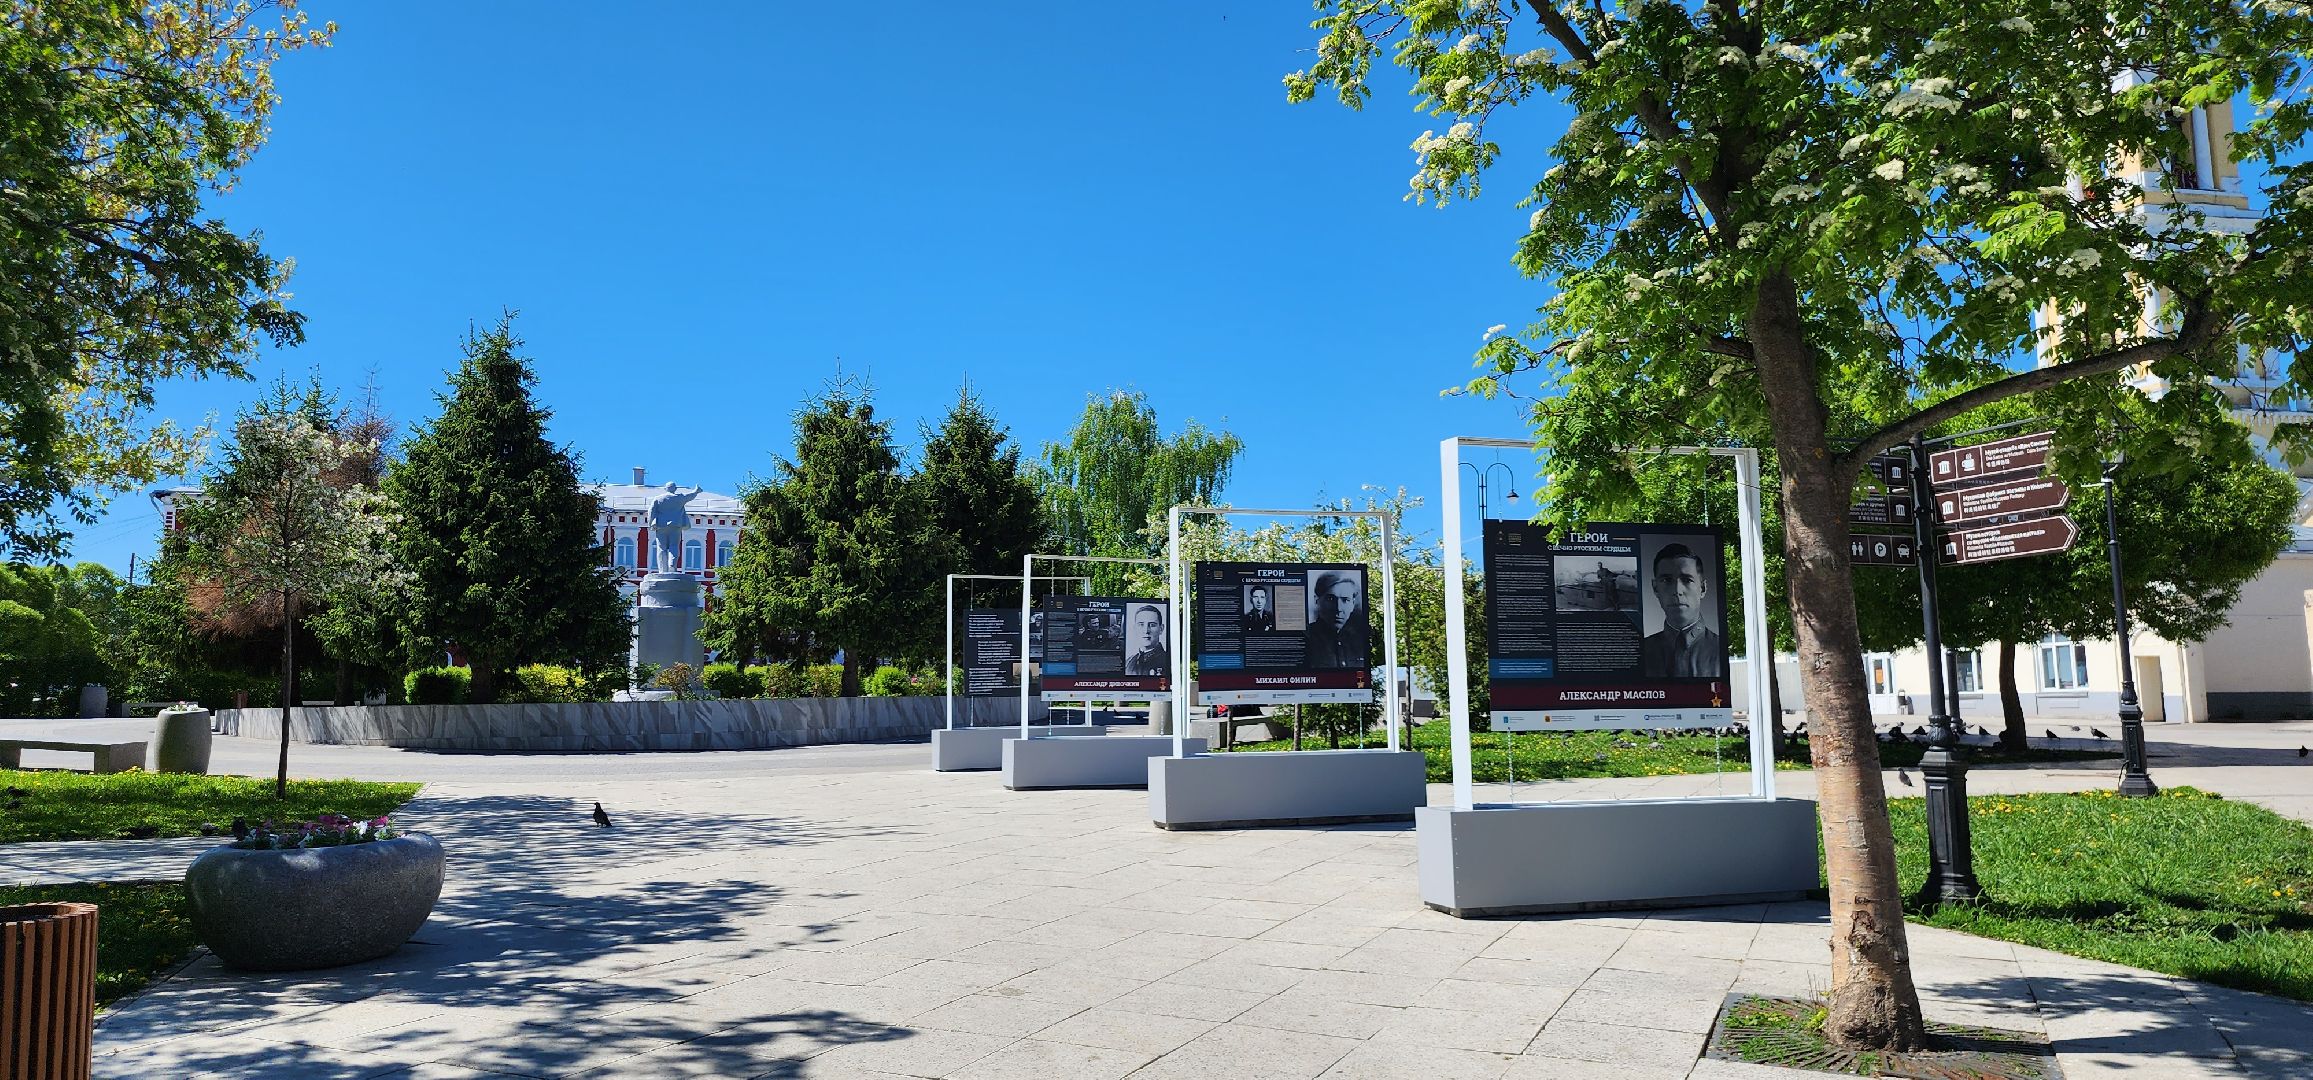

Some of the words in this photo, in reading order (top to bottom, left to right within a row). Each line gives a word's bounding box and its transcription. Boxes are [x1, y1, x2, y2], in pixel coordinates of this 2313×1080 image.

[1570, 532, 1609, 543] ГЕРОИ
[1257, 569, 1285, 577] ГЕРОИ
[1289, 676, 1317, 684] ФИЛИН
[1559, 691, 1621, 701] АЛЕКСАНДР
[1623, 690, 1666, 699] МАСЛОВ
